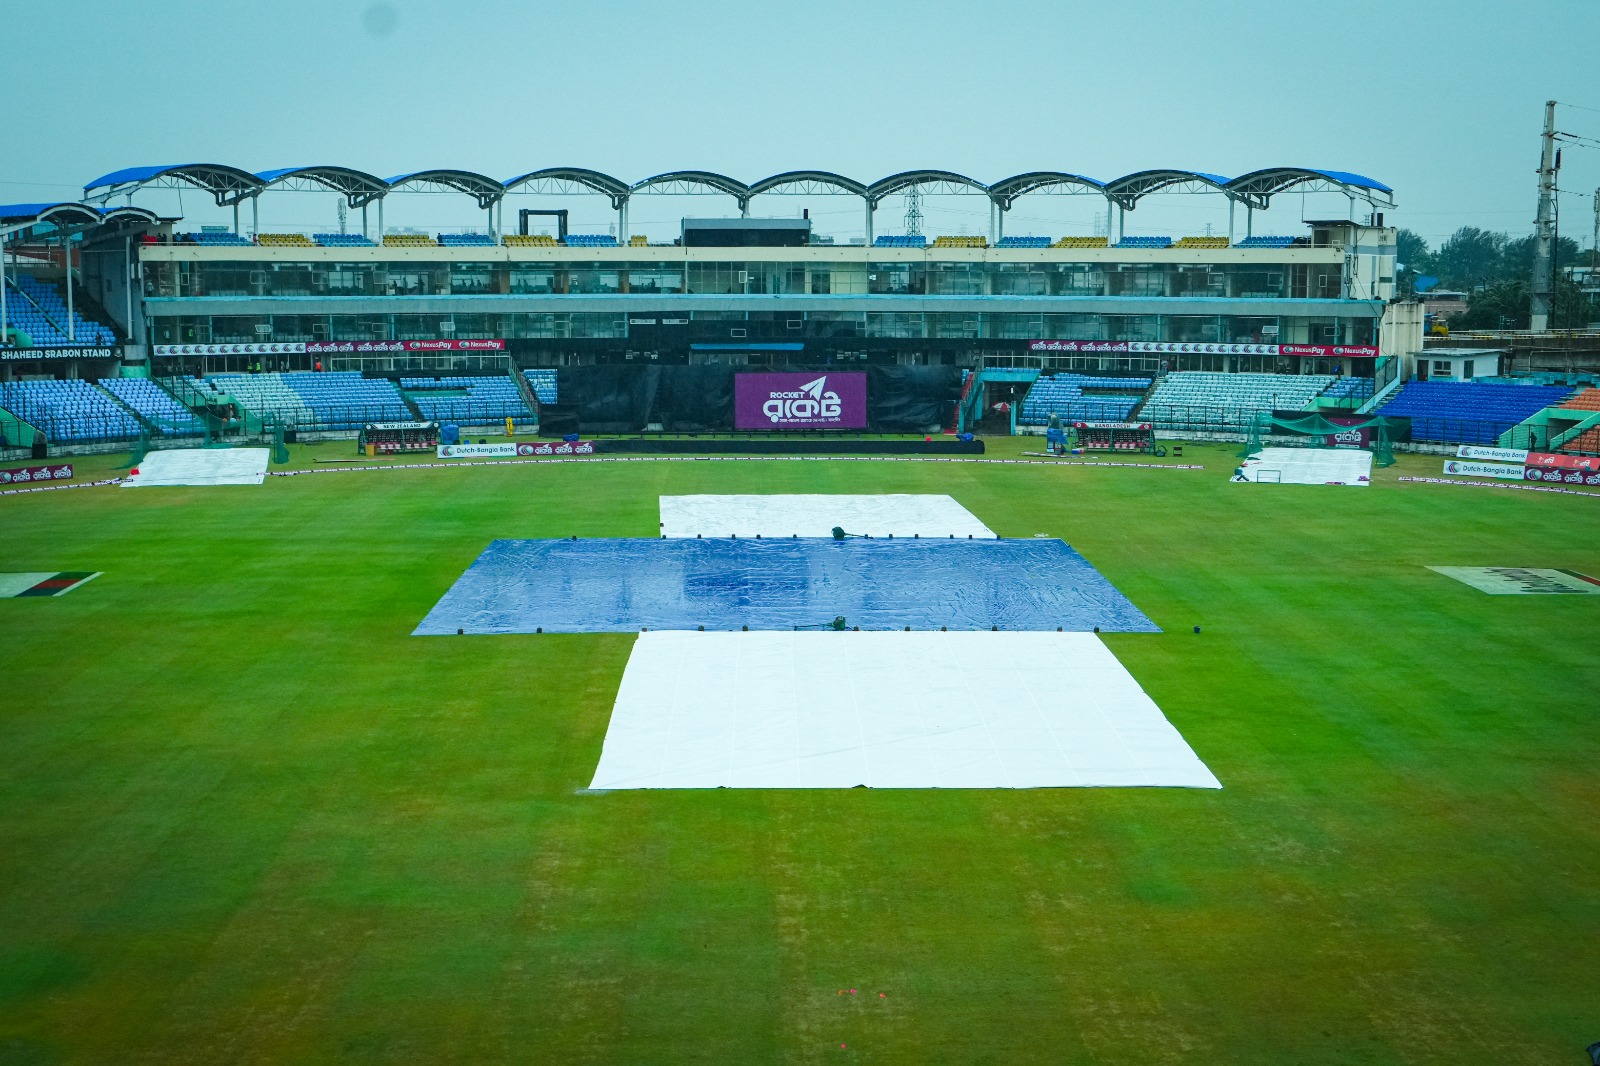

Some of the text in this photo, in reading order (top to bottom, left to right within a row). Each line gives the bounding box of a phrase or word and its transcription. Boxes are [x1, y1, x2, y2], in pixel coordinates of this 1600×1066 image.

[422, 341, 452, 350] NexusPay
[470, 341, 501, 349] NexusPay
[1, 348, 111, 359] SHAHEED SRABON STAND
[1294, 346, 1325, 355] NexusPay
[1344, 347, 1376, 356] NexusPay
[770, 391, 805, 399] ROCKET
[1473, 449, 1511, 458] Dutch-Bangla
[1462, 465, 1505, 474] Dutch-Bangla
